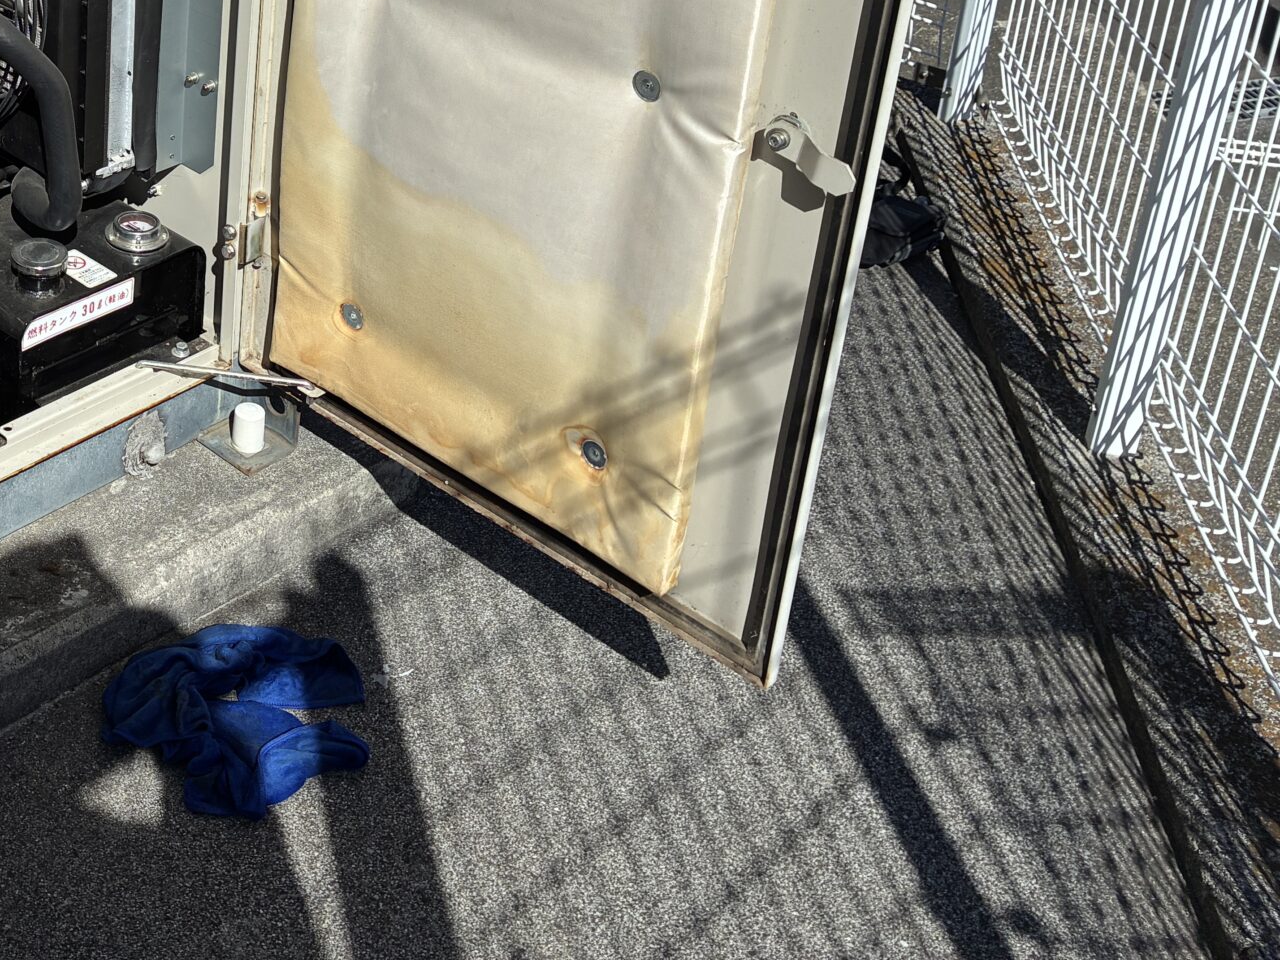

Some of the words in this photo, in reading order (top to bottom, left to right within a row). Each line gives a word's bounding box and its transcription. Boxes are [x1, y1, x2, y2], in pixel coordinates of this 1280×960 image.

[28, 310, 77, 340] 燃料タンク
